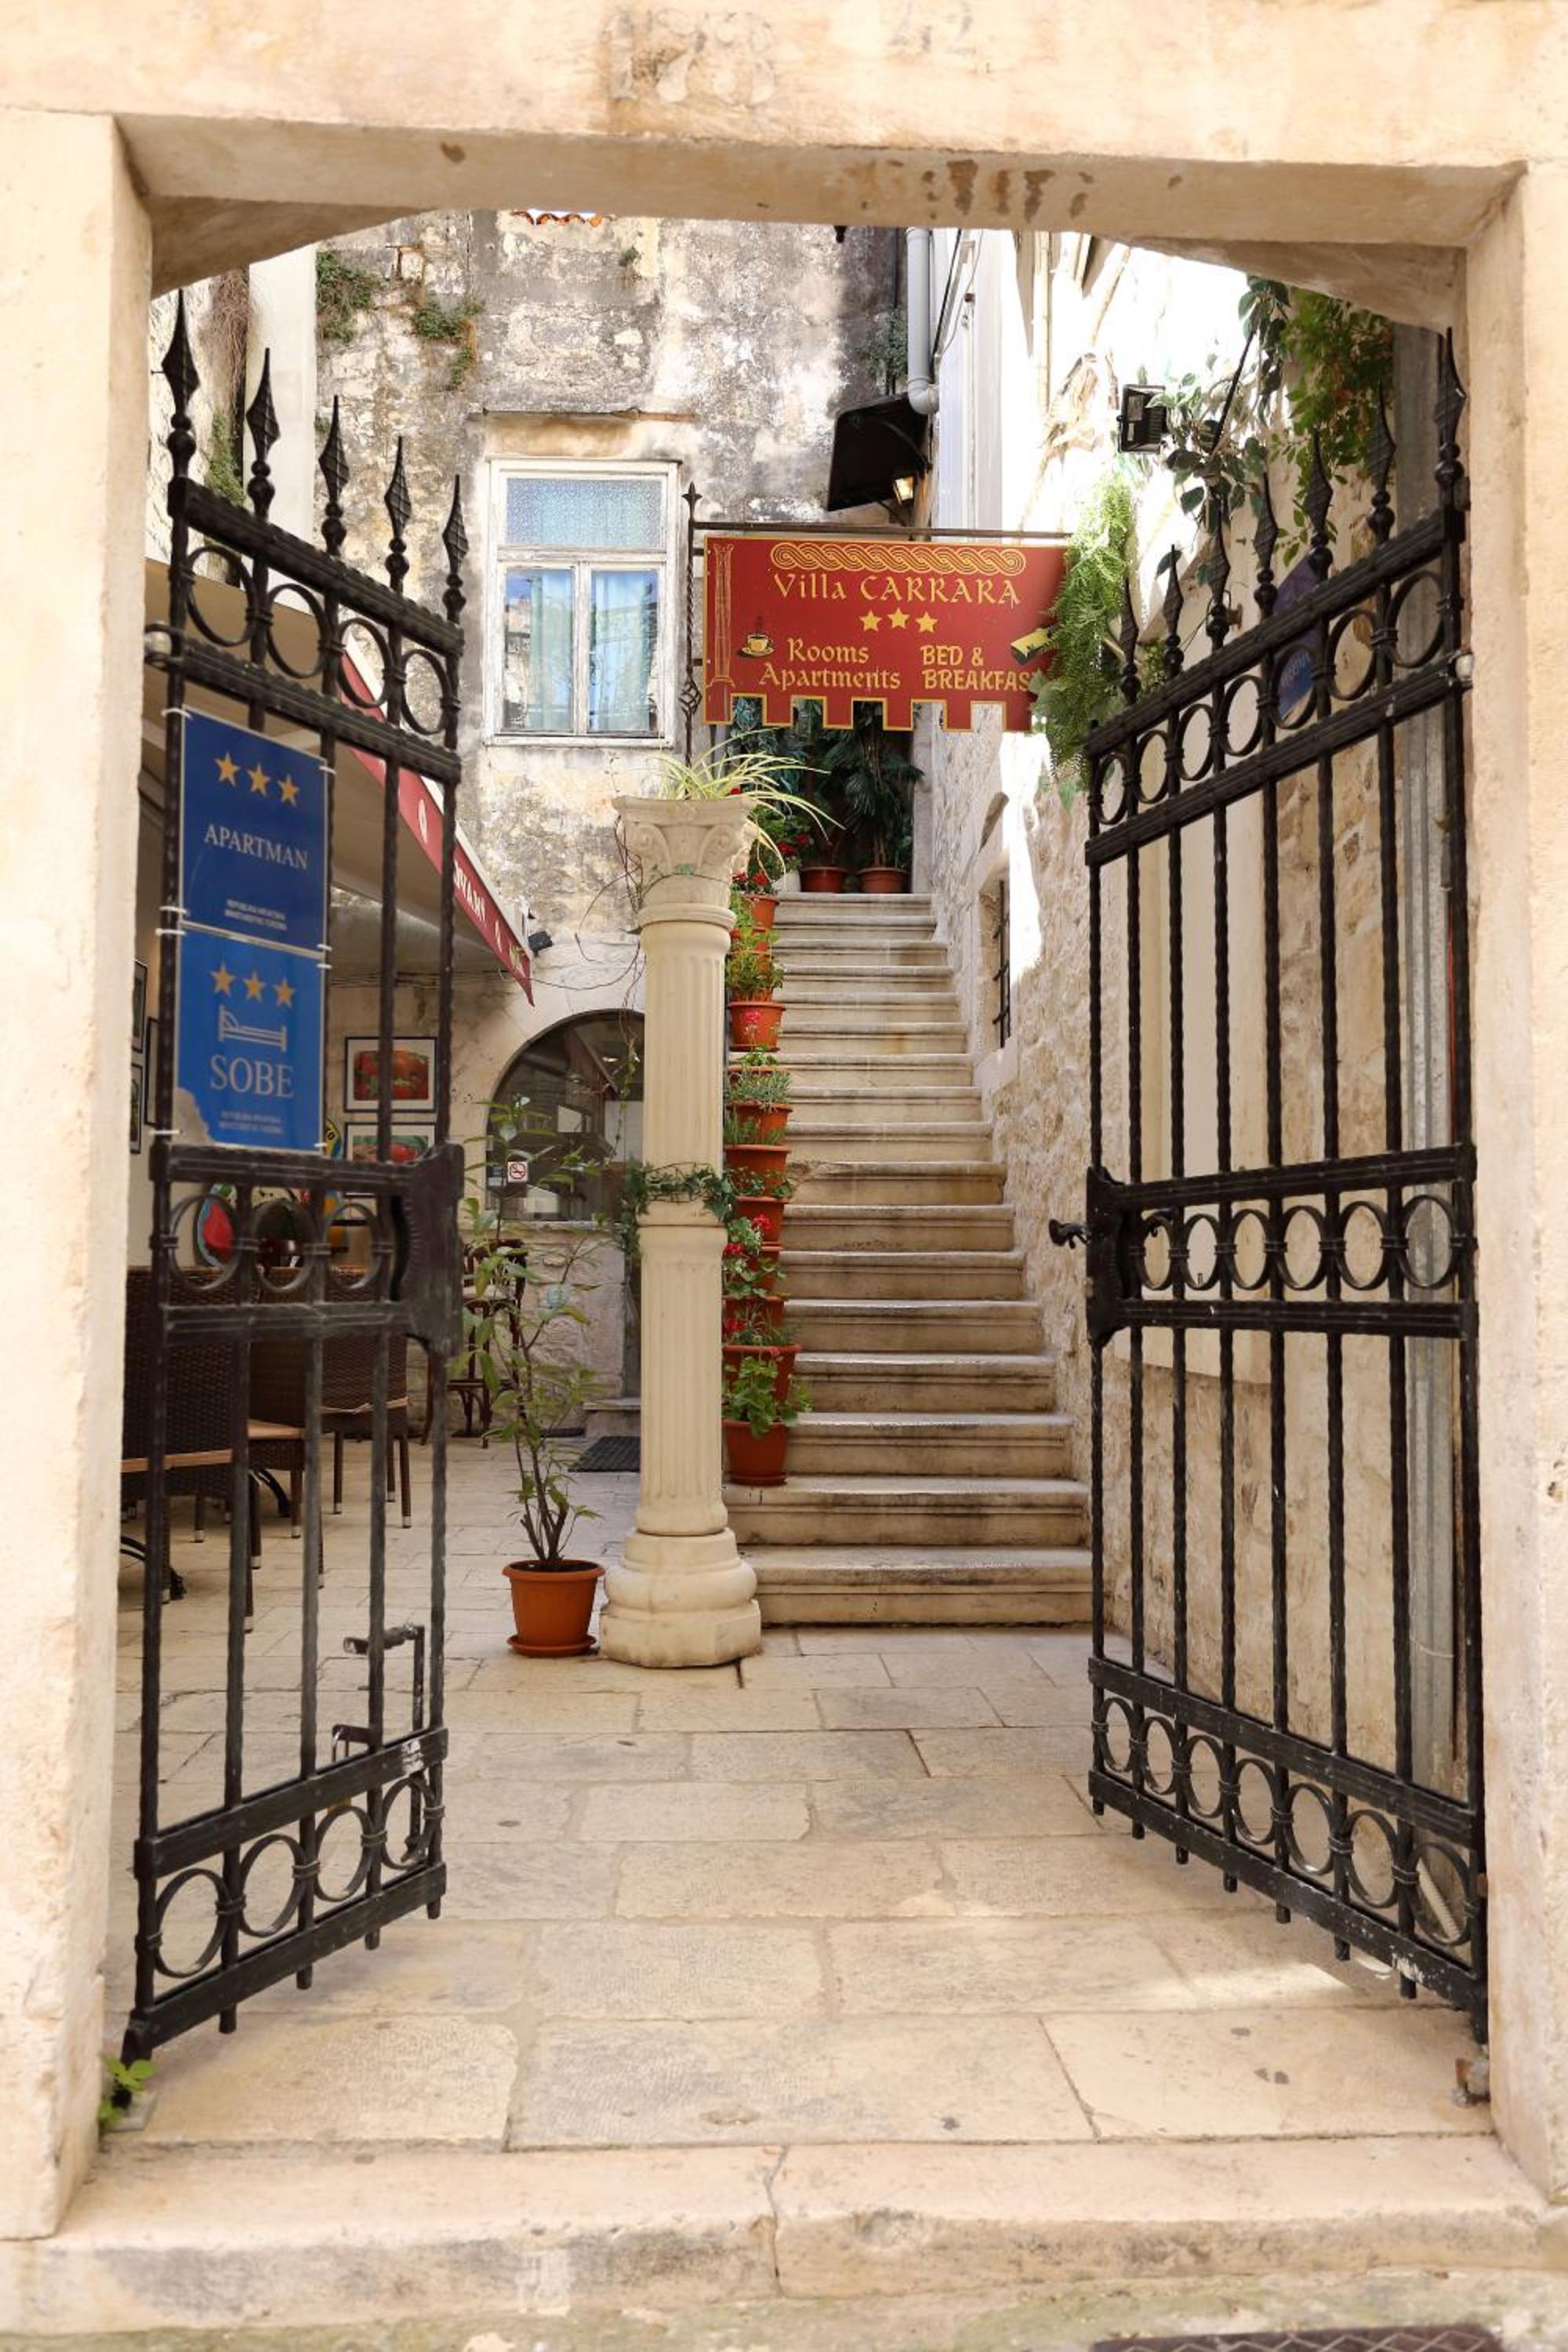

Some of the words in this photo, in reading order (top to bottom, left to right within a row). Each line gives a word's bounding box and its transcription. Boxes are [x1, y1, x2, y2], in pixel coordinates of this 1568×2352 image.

[774, 572, 848, 600] Villa
[860, 575, 1021, 608] CARRARA
[787, 637, 869, 664] Rooms
[920, 645, 964, 666] BED
[971, 647, 985, 666] &
[759, 663, 902, 690] Apartments
[922, 669, 1033, 691] BREAKFAS
[204, 823, 309, 870] APARTMAN
[209, 1054, 295, 1098] SOBE
